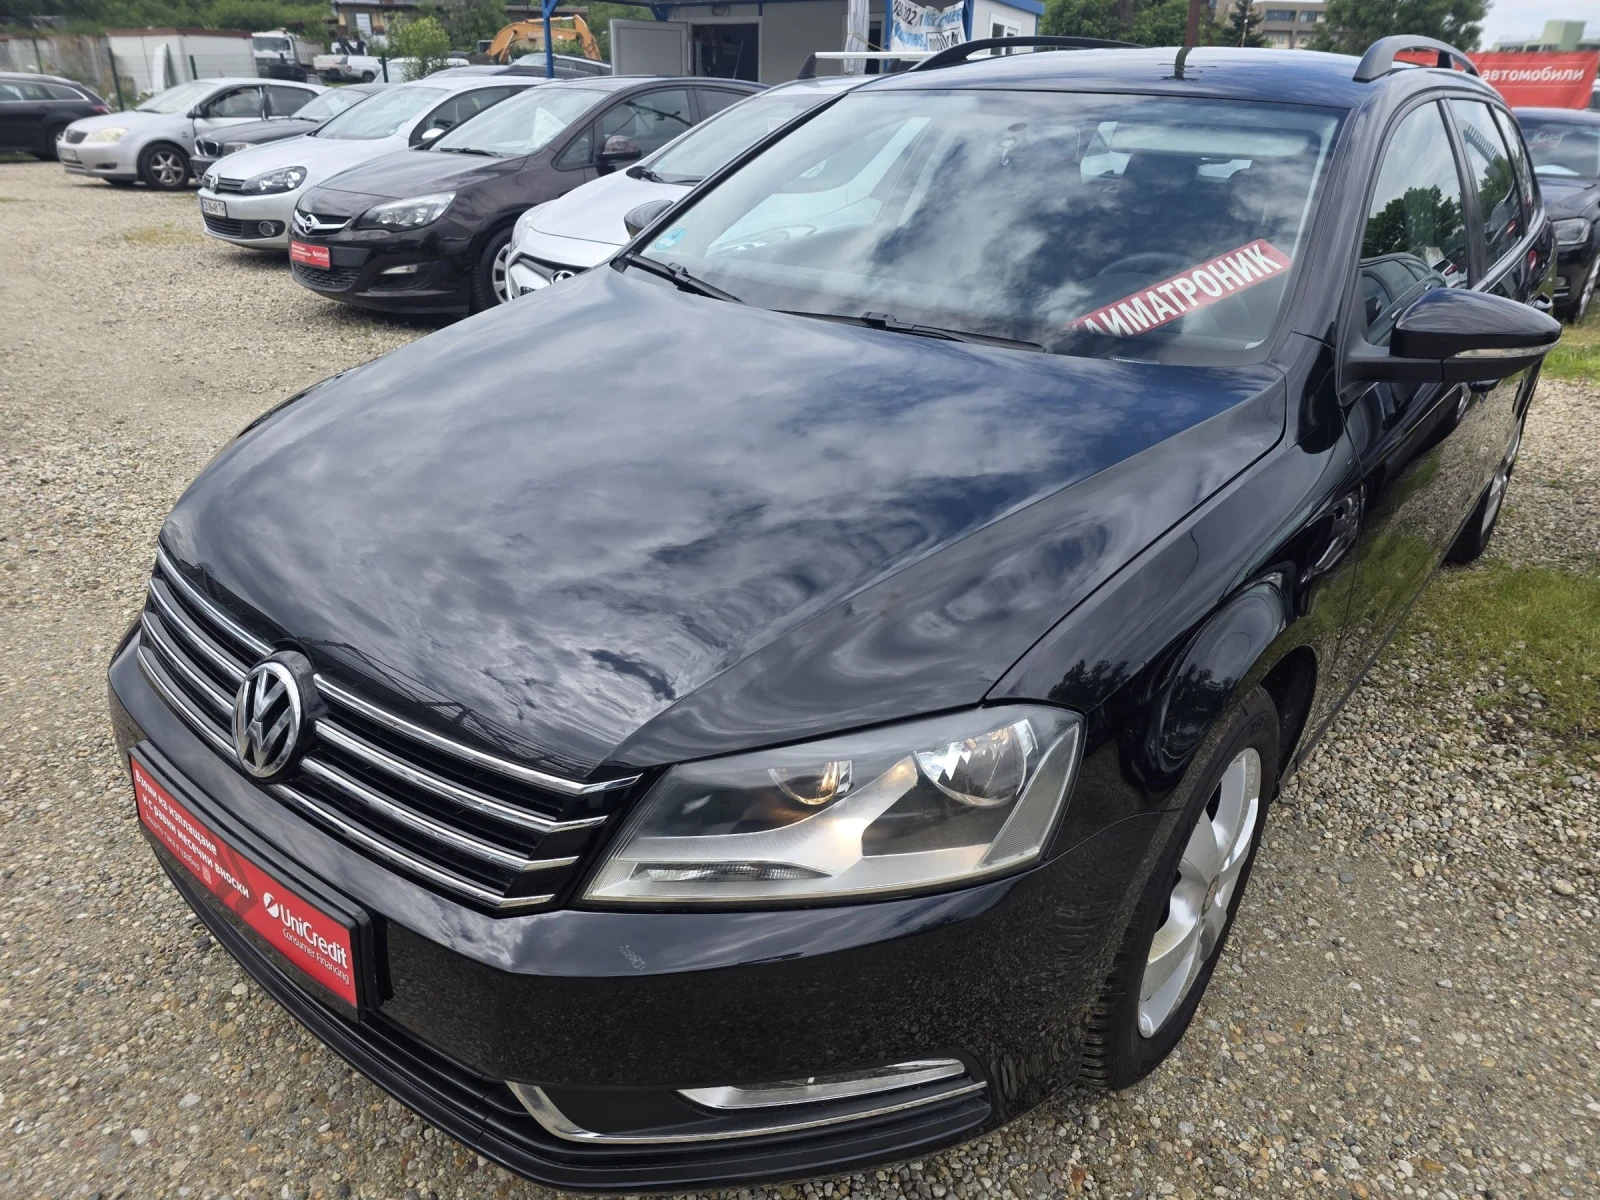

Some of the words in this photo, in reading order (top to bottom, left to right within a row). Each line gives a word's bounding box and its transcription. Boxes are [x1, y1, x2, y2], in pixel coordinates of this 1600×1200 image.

[1482, 67, 1584, 81] автомобили
[1071, 243, 1283, 338] ЛИМАТРОНИК
[135, 769, 158, 801] Вземи
[158, 794, 168, 811] на
[168, 805, 217, 856] изплащане
[142, 793, 148, 805] и
[153, 805, 177, 835] равни
[177, 829, 214, 869] месечни
[215, 861, 250, 899] вноски
[280, 904, 348, 969] UniCredit
[283, 928, 316, 959] Consumer
[316, 952, 349, 985] Financing
